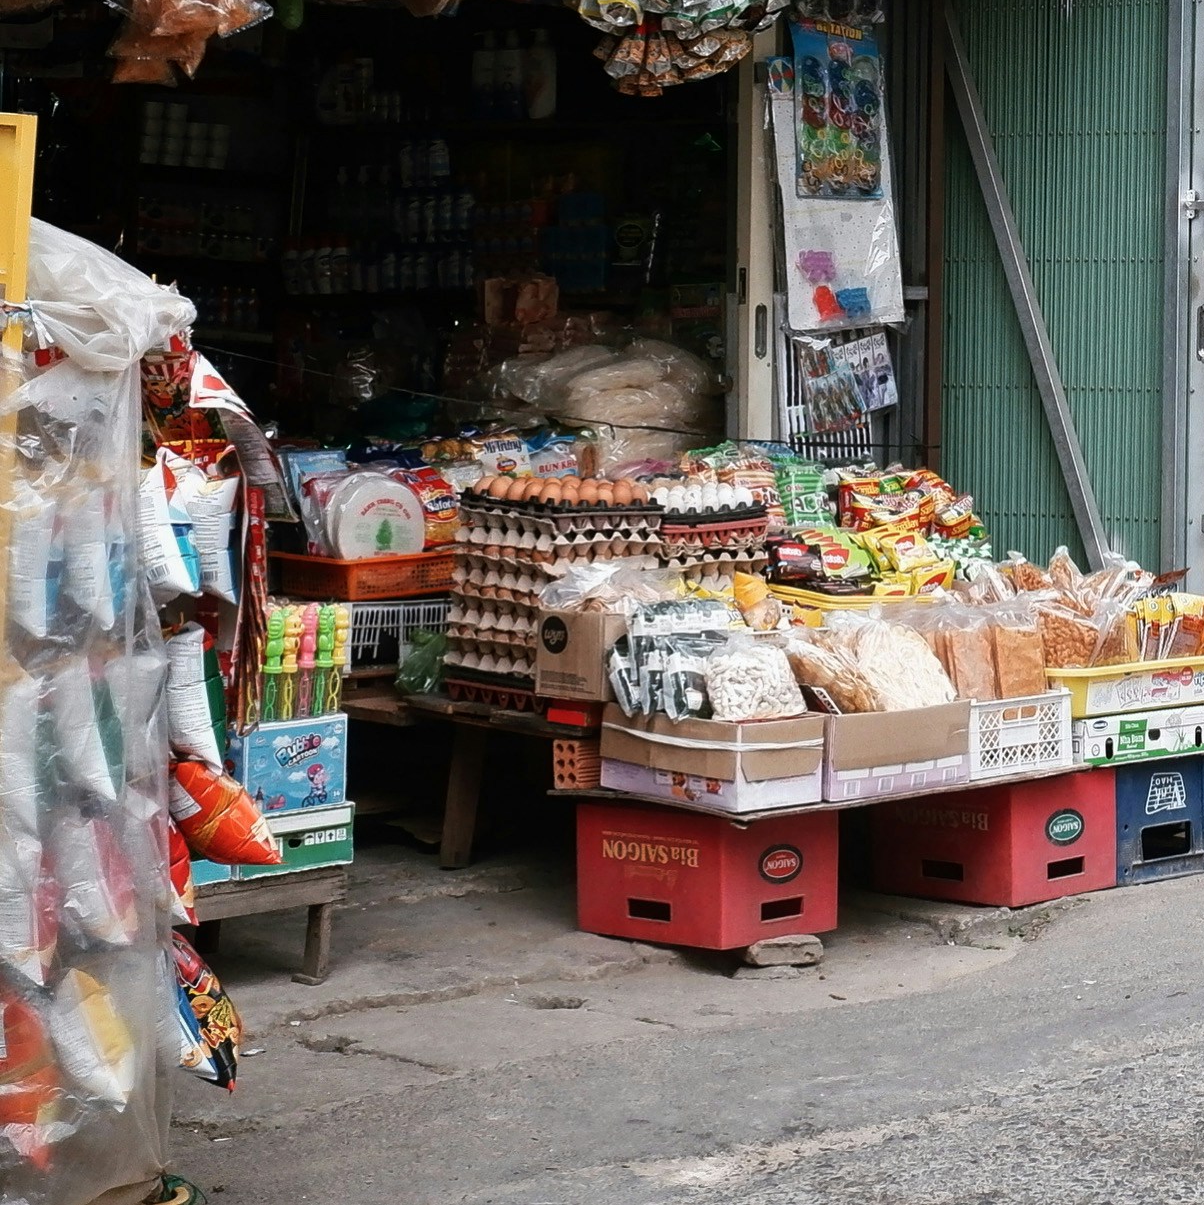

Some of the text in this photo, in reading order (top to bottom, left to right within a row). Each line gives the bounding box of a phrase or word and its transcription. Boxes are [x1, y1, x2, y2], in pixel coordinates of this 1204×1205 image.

[275, 733, 322, 767] Bubble
[961, 811, 989, 831] Bia
[1051, 821, 1079, 833] SAIGON
[601, 838, 699, 869] Bia SAIGON
[767, 858, 797, 871] SAIGON
